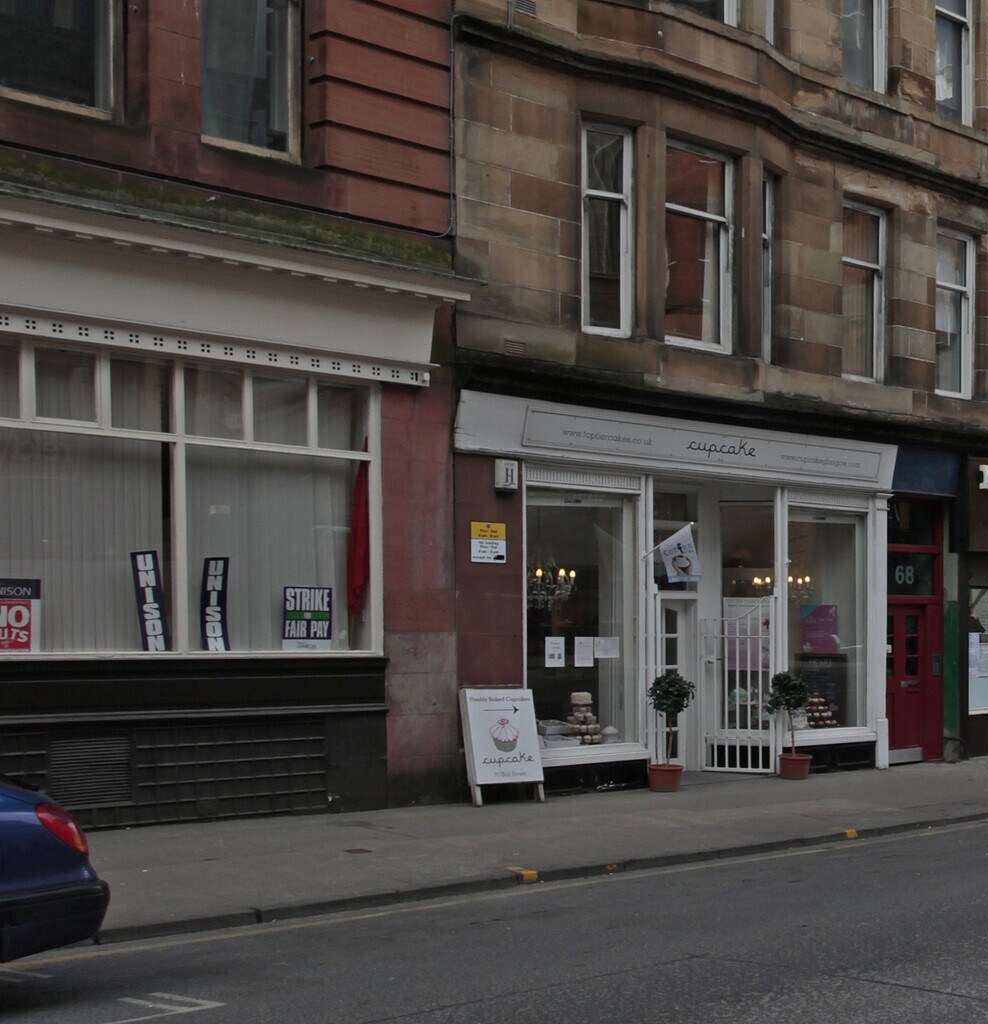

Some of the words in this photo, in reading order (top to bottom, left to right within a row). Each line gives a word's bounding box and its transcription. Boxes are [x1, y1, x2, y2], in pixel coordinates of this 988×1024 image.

[895, 565, 915, 584] 68
[136, 553, 166, 652] UNISON
[205, 559, 226, 652] UNISON
[285, 587, 330, 612] STRIKE
[284, 620, 307, 638] FAIR
[310, 620, 330, 638] PAY
